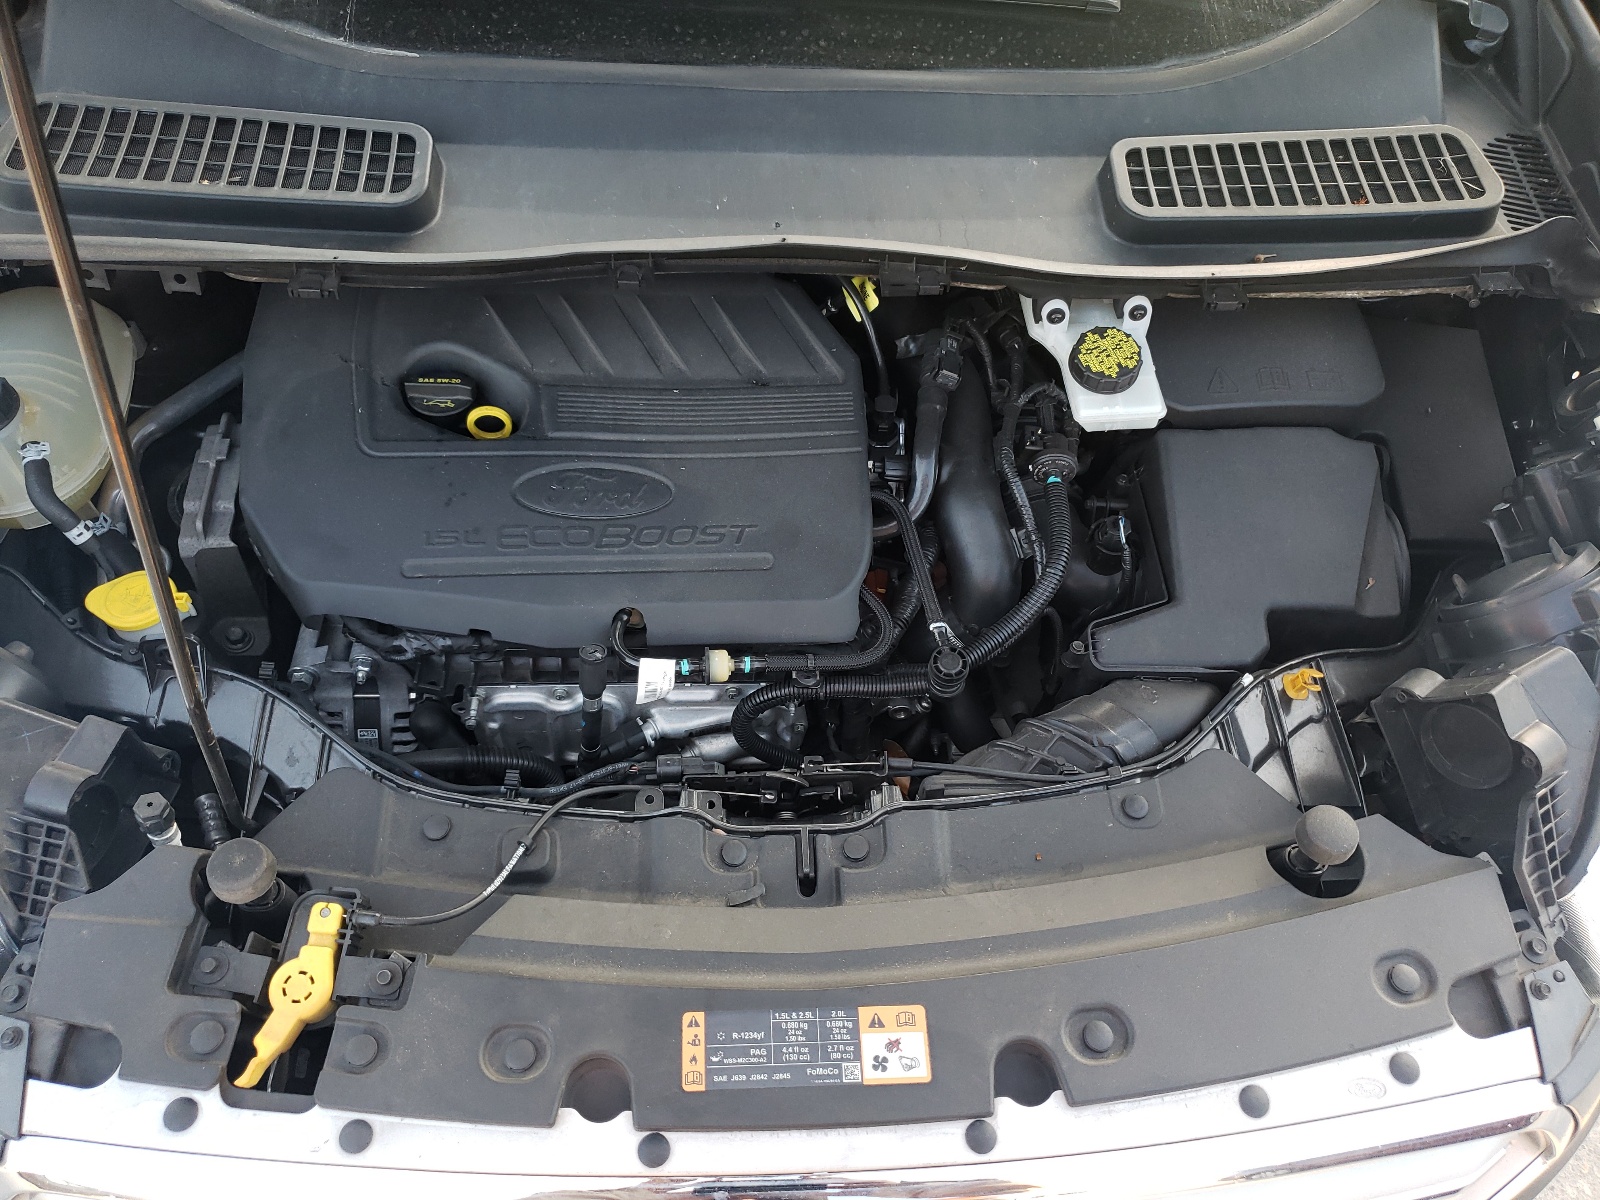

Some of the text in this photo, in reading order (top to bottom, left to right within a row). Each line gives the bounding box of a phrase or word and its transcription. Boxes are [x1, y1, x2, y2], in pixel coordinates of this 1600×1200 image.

[542, 471, 647, 511] Ford
[800, 1021, 808, 1029] kg
[844, 1020, 852, 1028] kg
[732, 1032, 765, 1040] R-1234yf
[806, 1067, 839, 1075] FoMoCo
